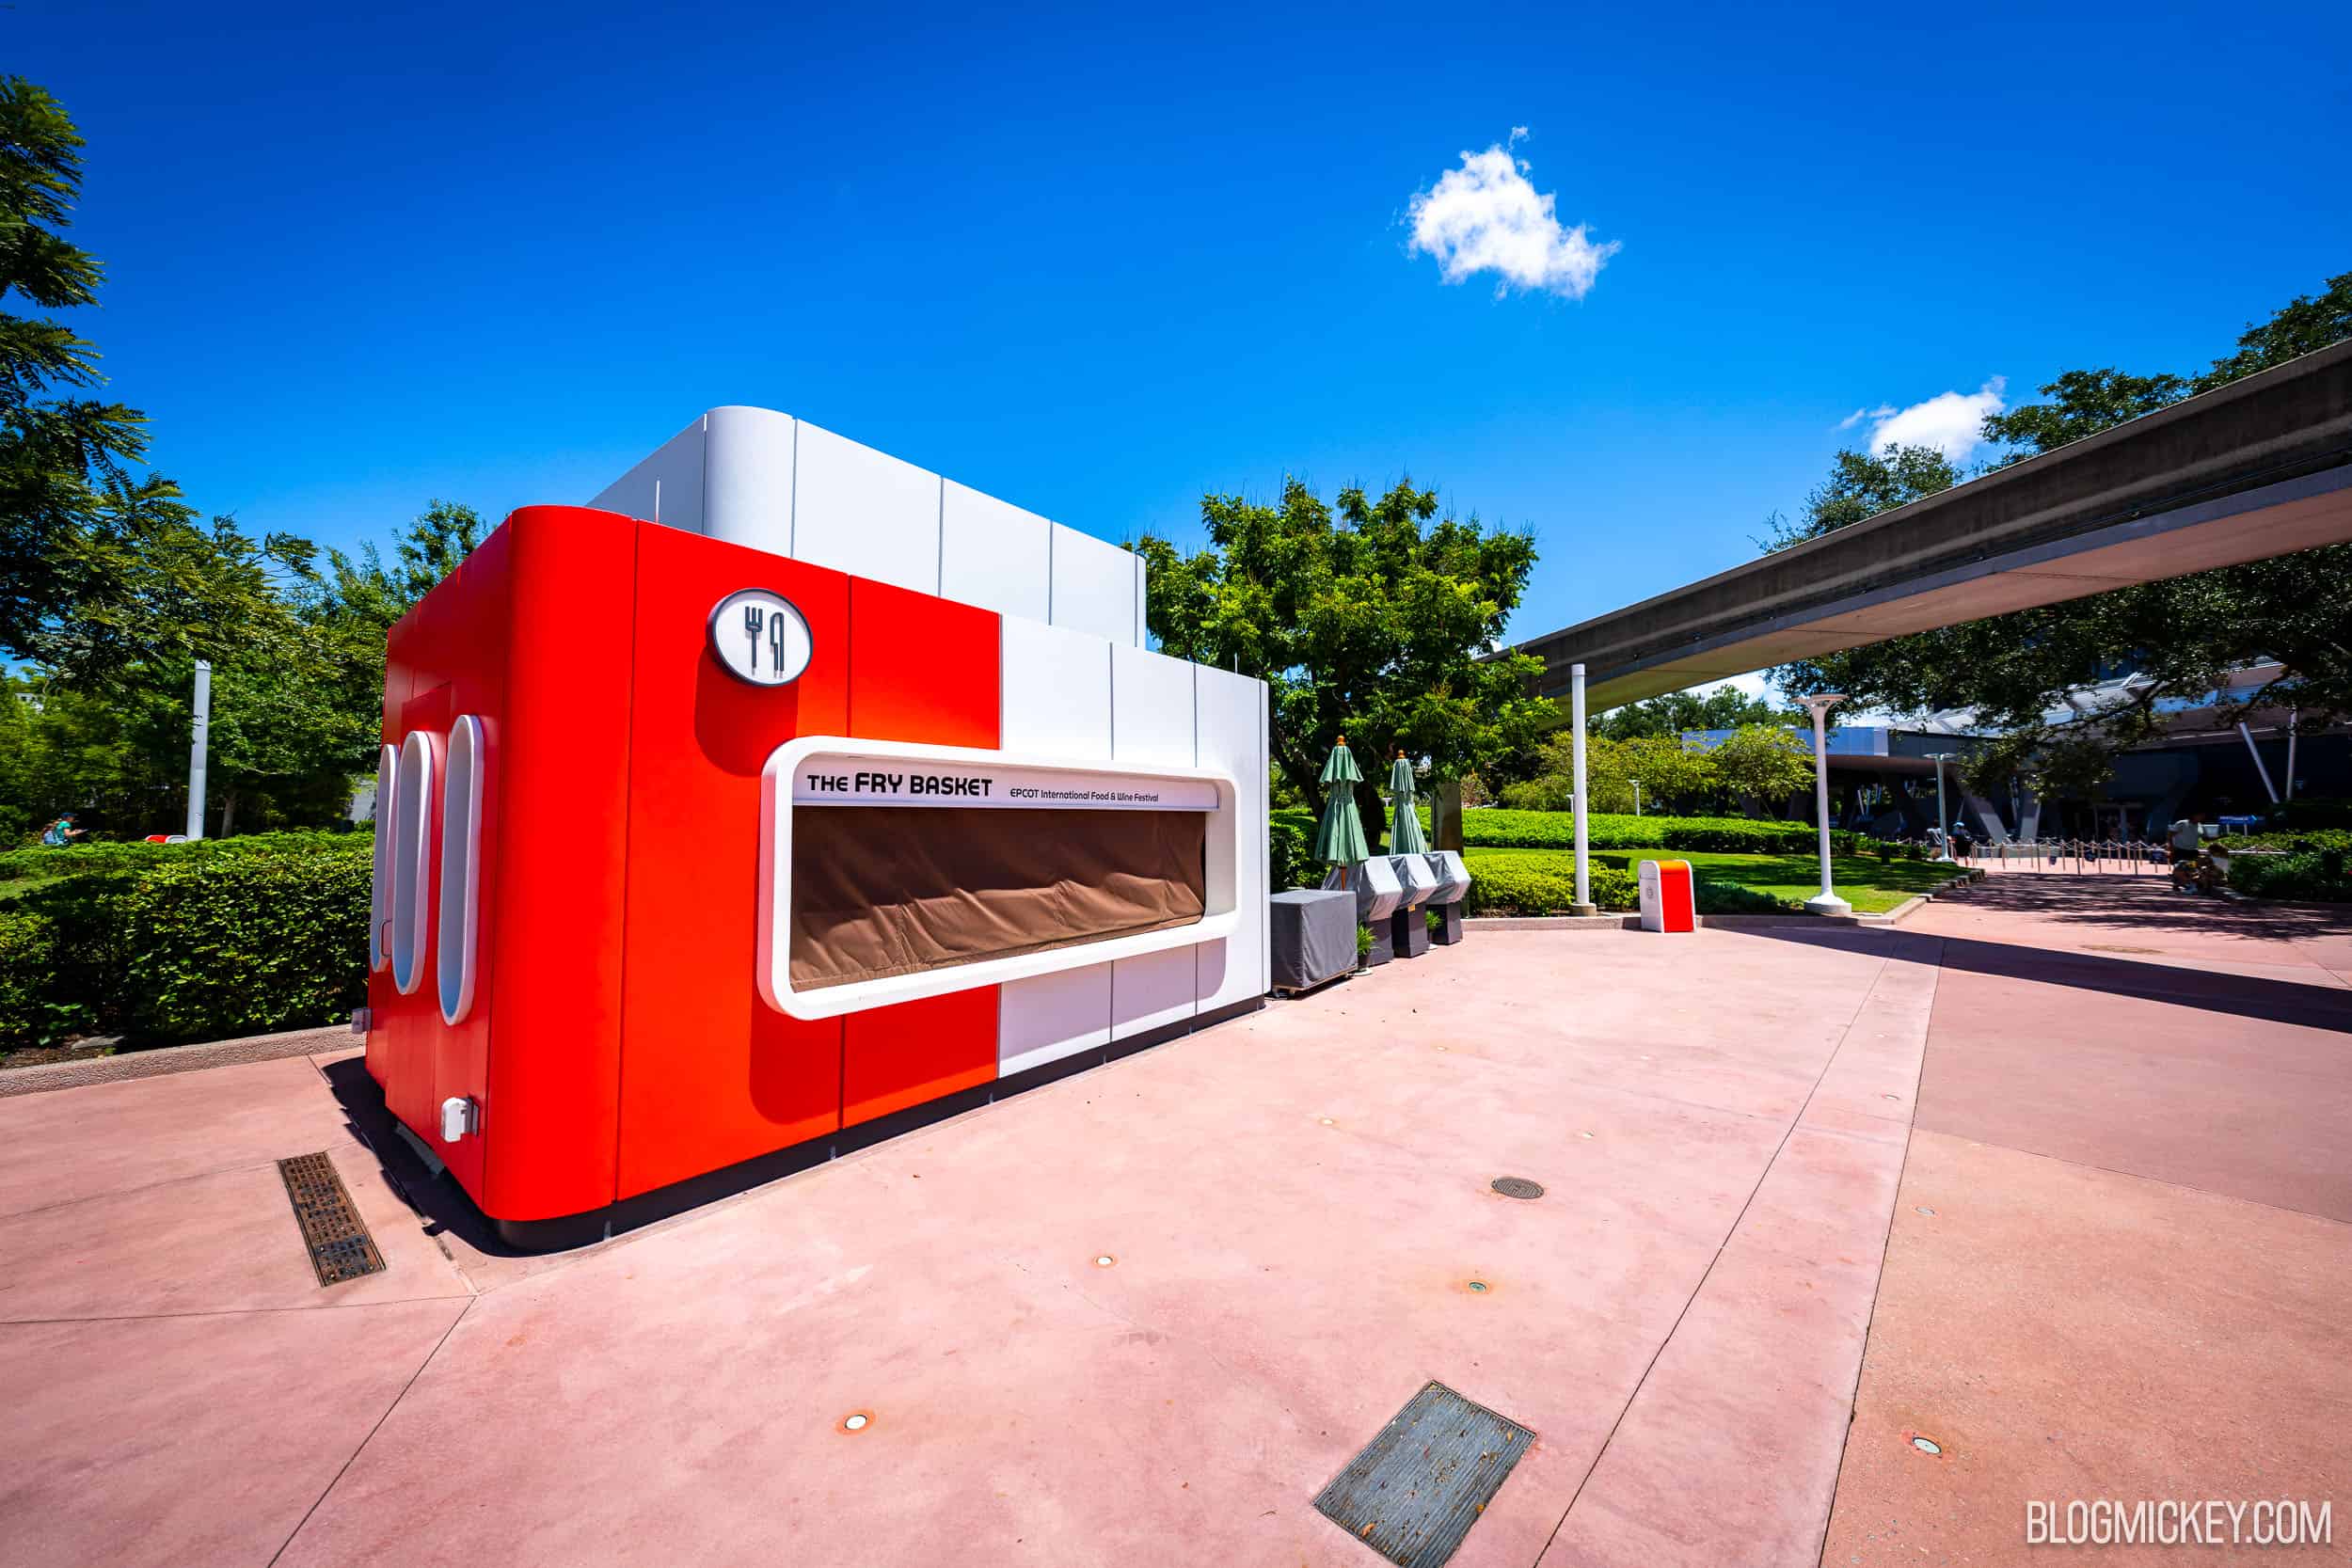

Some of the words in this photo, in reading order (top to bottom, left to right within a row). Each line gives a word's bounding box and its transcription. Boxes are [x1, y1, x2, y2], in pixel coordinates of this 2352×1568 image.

[807, 775, 849, 792] THE
[855, 772, 903, 793] FRY
[910, 775, 993, 797] BASKET
[1009, 788, 1039, 799] EPCOT
[1041, 789, 1089, 800] International
[1090, 791, 1109, 800] Food
[1110, 792, 1116, 800] &
[1117, 792, 1134, 801] Wine
[1134, 793, 1159, 802] Festival
